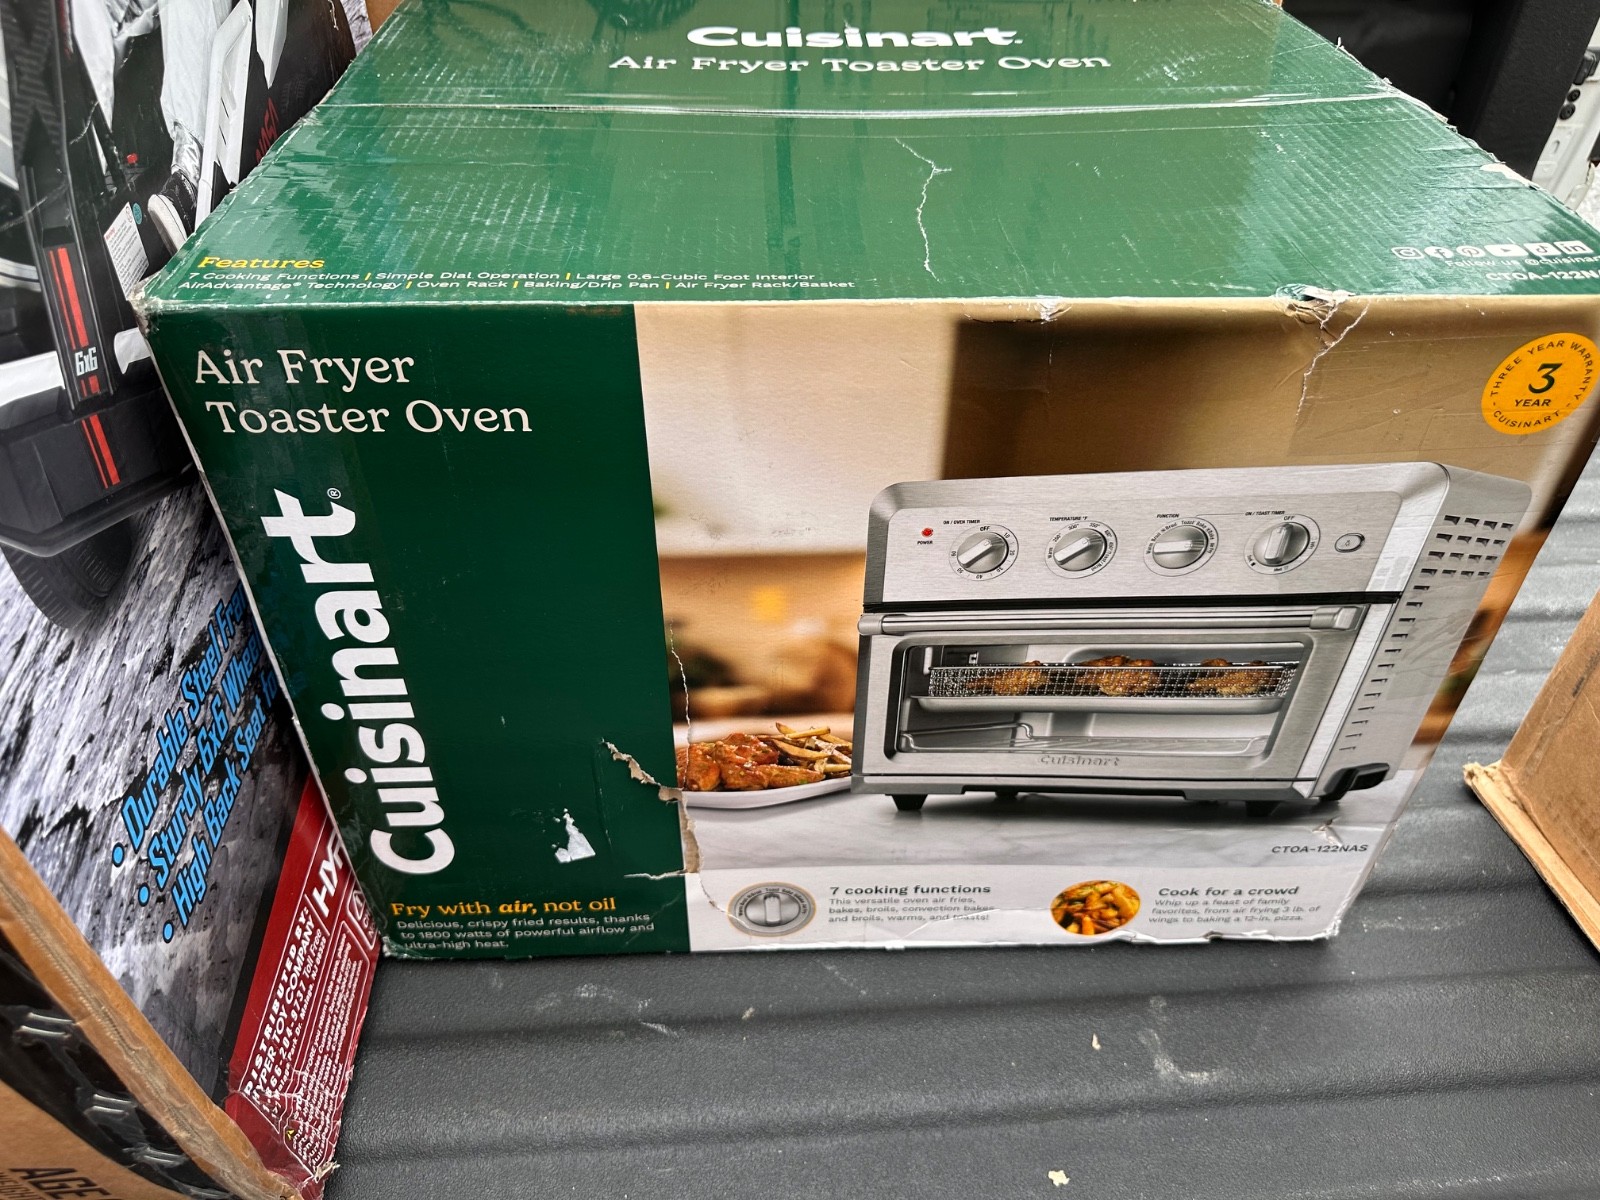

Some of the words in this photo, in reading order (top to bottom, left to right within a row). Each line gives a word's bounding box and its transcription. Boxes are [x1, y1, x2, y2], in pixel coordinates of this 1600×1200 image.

[609, 55, 676, 70] Air
[691, 56, 809, 74] Fryer
[822, 57, 984, 73] Toaster
[998, 55, 1111, 70] Oven
[197, 256, 325, 269] Features
[1524, 255, 1600, 266] @cuisinar
[188, 272, 199, 280] 7
[203, 272, 273, 282] Cooking
[276, 272, 360, 281] Functions
[375, 272, 434, 282] Simple
[440, 271, 472, 280] Dial
[477, 271, 560, 282] Operation
[576, 272, 622, 282] Large
[627, 272, 708, 281] 0.6-Cubic
[714, 273, 750, 281] Foot
[756, 272, 815, 281] Interior
[307, 281, 402, 291] Technology
[417, 281, 460, 289] Oven
[467, 281, 508, 289] Rack
[524, 281, 623, 290] Baking/Drip
[629, 281, 660, 289] Pan
[675, 281, 699, 289] Air
[704, 281, 746, 290] Fryer
[752, 281, 856, 289] Rack/Basket
[75, 347, 98, 377] 6x6
[1490, 356, 1523, 397] THREE
[1527, 340, 1565, 355] YEAR
[1570, 341, 1593, 400] WARRANTY
[195, 349, 263, 384] Air
[277, 349, 414, 393] Fryer
[1528, 363, 1563, 394] 3
[1514, 398, 1552, 407] YEAR
[205, 401, 390, 433] Toaster
[405, 399, 533, 433] Oven
[1493, 410, 1561, 428] CUISINART
[122, 708, 189, 850] Durable
[181, 619, 223, 721] Steel
[215, 580, 248, 652] Fra
[1039, 754, 1120, 767] Cuisinart
[148, 763, 205, 892] Sturdy
[197, 691, 229, 776] 6x6
[172, 833, 212, 929] High
[203, 756, 242, 849] Back
[233, 694, 267, 773] Seat
[1271, 844, 1369, 854] CTOA-122NAS
[830, 886, 839, 895] 7
[845, 885, 909, 896] cooking
[913, 884, 991, 894] functions
[1158, 887, 1200, 896] Cook
[1205, 886, 1229, 896] for
[1233, 888, 1242, 896] a
[1248, 886, 1299, 896] crowd
[390, 902, 430, 918] Fry
[437, 901, 492, 915] with
[498, 899, 538, 916] air,
[543, 899, 583, 912] not
[588, 897, 617, 911] oil
[866, 905, 899, 913] broils,
[902, 904, 960, 912] convection
[950, 896, 976, 904] fries,
[1154, 899, 1181, 907] Whip
[1257, 898, 1290, 906] family
[852, 914, 884, 922] broils,
[1232, 906, 1247, 914] air
[1249, 906, 1281, 915] frying
[397, 920, 464, 930] Delicious,
[467, 918, 509, 929] crispy
[512, 917, 545, 927] fried
[549, 916, 600, 926] results,
[603, 913, 651, 923] thanks
[1148, 916, 1179, 924] wings
[1197, 916, 1232, 924] baking
[400, 931, 416, 940] to
[418, 930, 451, 940] 1800
[454, 930, 493, 939] watts
[496, 928, 511, 938] of
[514, 926, 576, 939] powerful
[578, 925, 626, 935] airflow
[629, 923, 656, 932] and
[404, 939, 471, 950] ultra-high
[474, 939, 510, 949] heat.
[302, 954, 314, 979] Toll
[309, 928, 322, 956] Free
[244, 943, 297, 1096] DISTRIBUTED
[294, 906, 309, 940] BY:
[252, 1045, 276, 1105] HYPER
[271, 1003, 288, 1043] TOY
[285, 914, 315, 1005] COMPANY
[287, 1037, 298, 1060] Park
[311, 964, 318, 980] NJ
[318, 1014, 332, 1054] Customer
[328, 984, 340, 1014] Service
[313, 1029, 321, 1047] you
[318, 1004, 328, 1029] return
